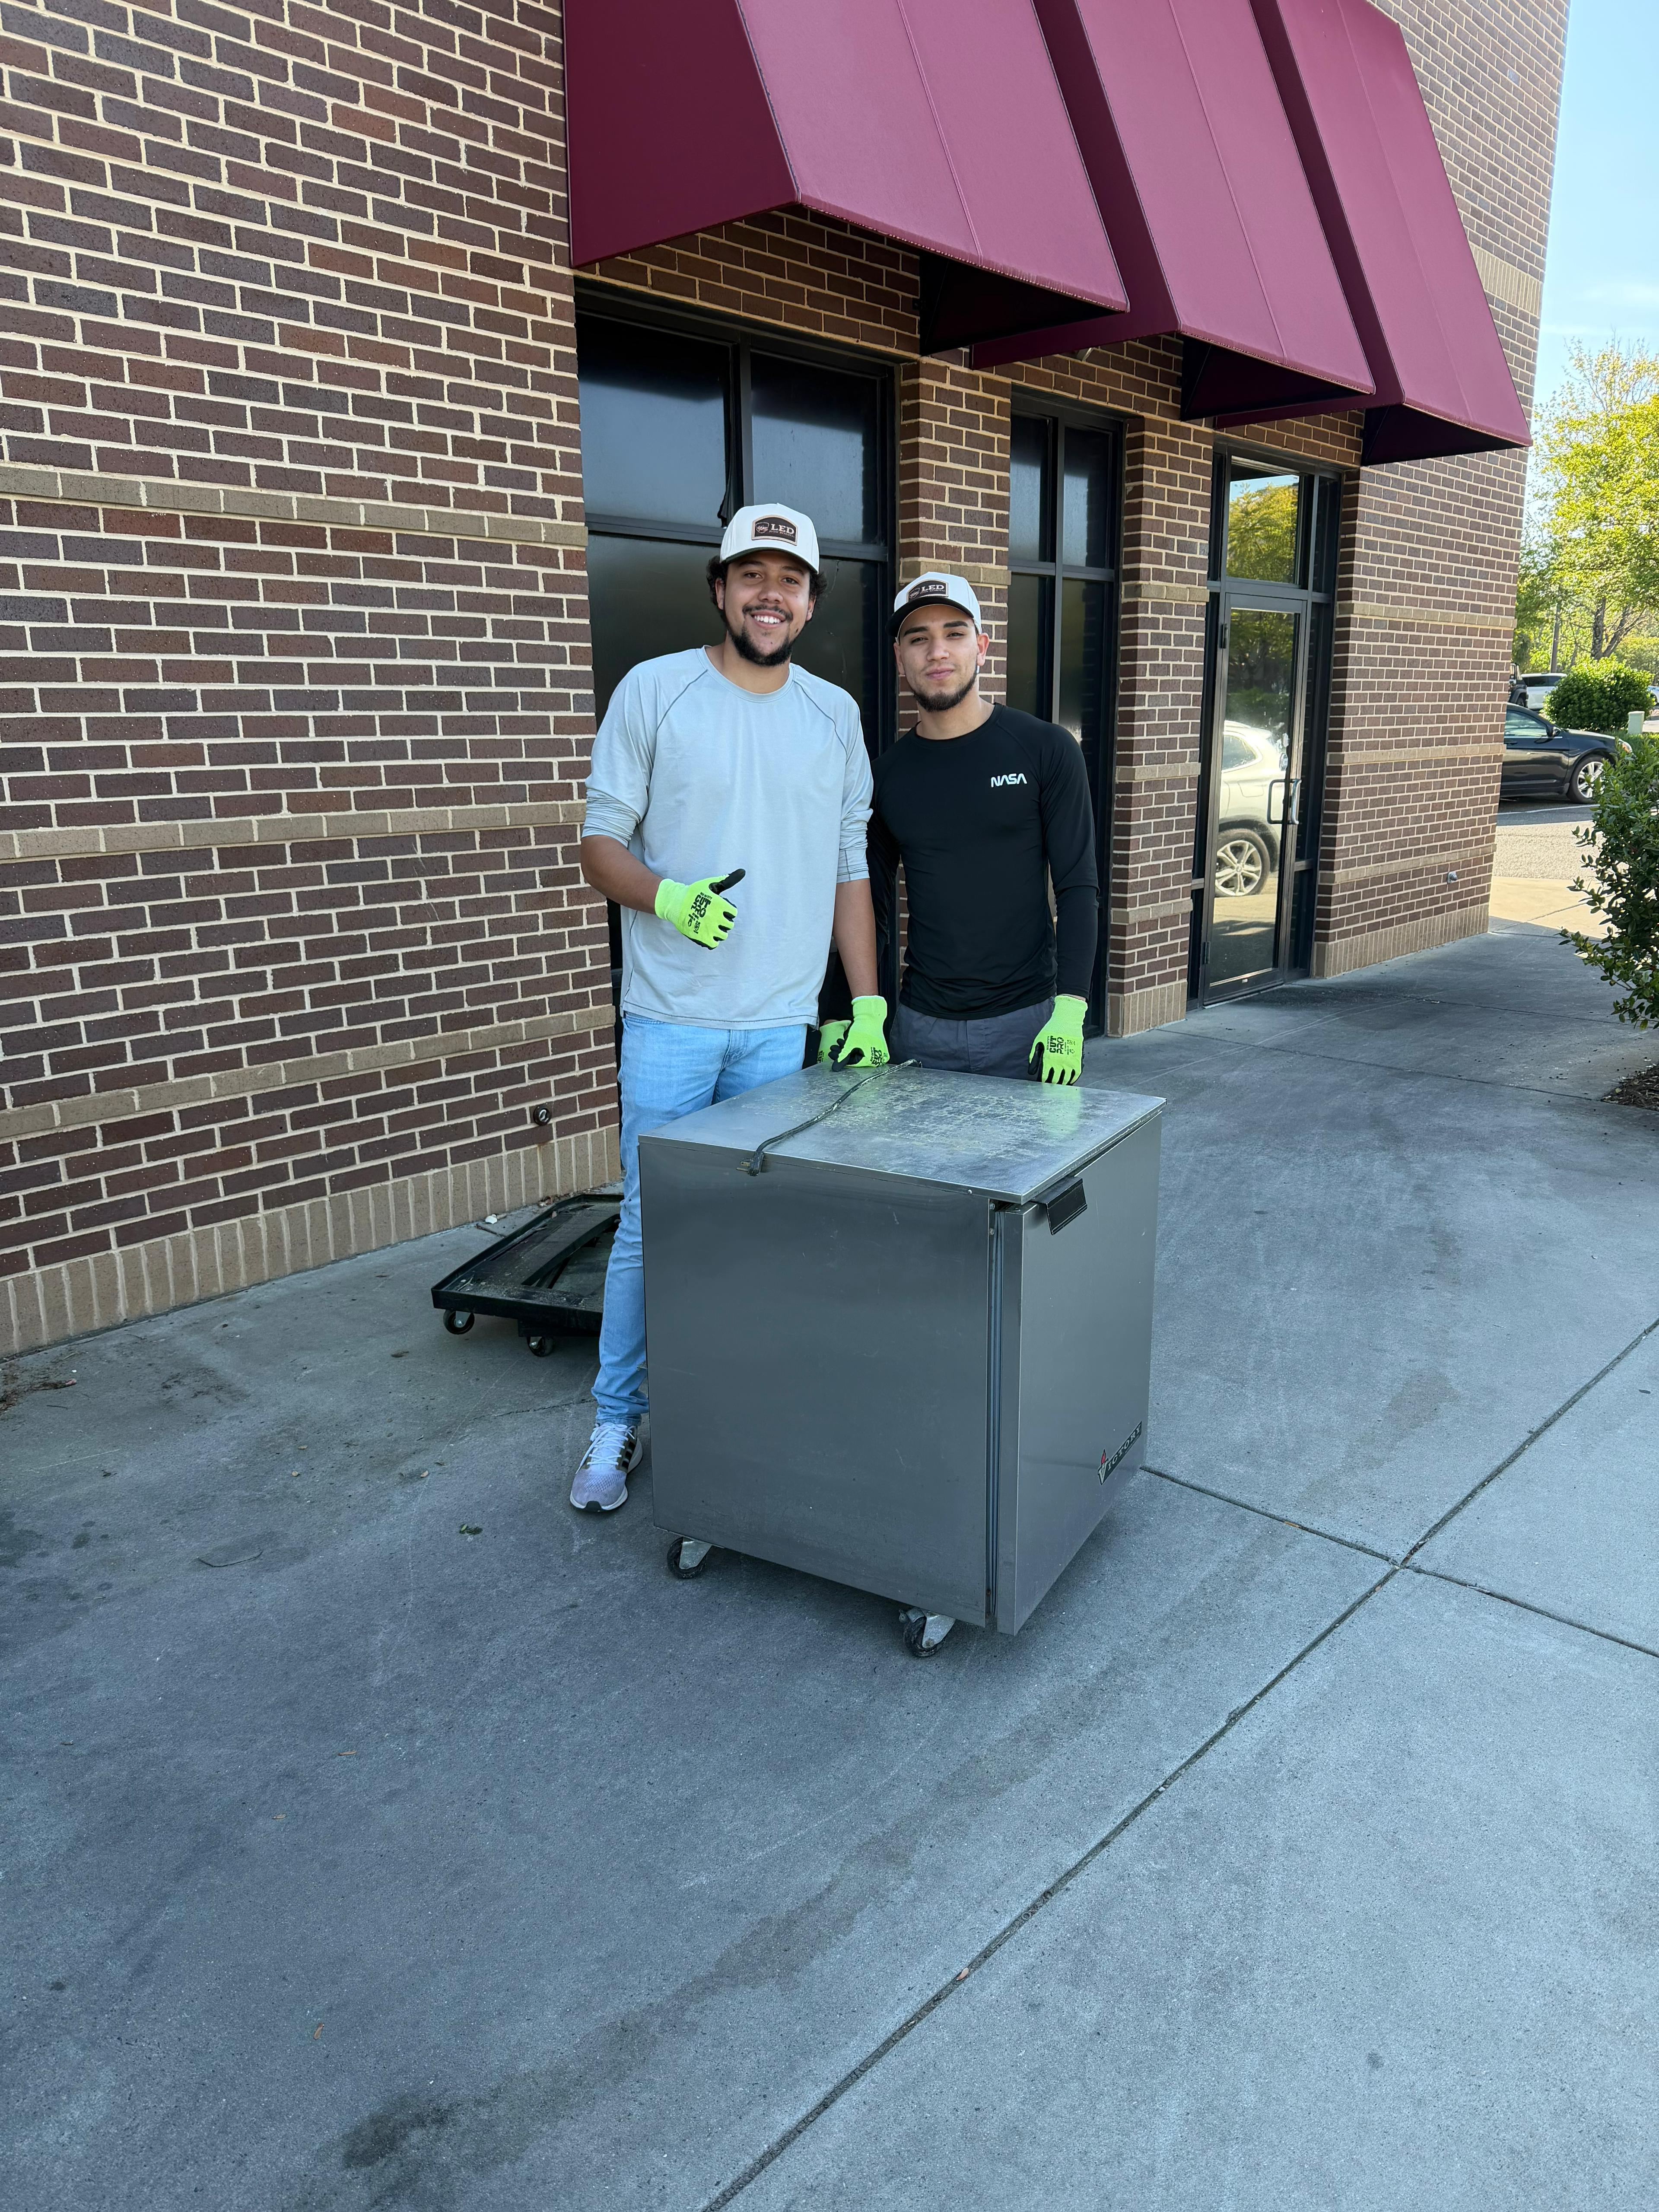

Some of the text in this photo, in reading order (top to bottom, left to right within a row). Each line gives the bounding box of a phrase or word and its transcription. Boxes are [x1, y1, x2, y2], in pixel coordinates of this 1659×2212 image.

[771, 524, 795, 534] LED
[991, 773, 1027, 788] NASA
[695, 894, 711, 909] CUT
[691, 902, 706, 918] PRO
[1098, 1424, 1141, 1484] VICTORY
